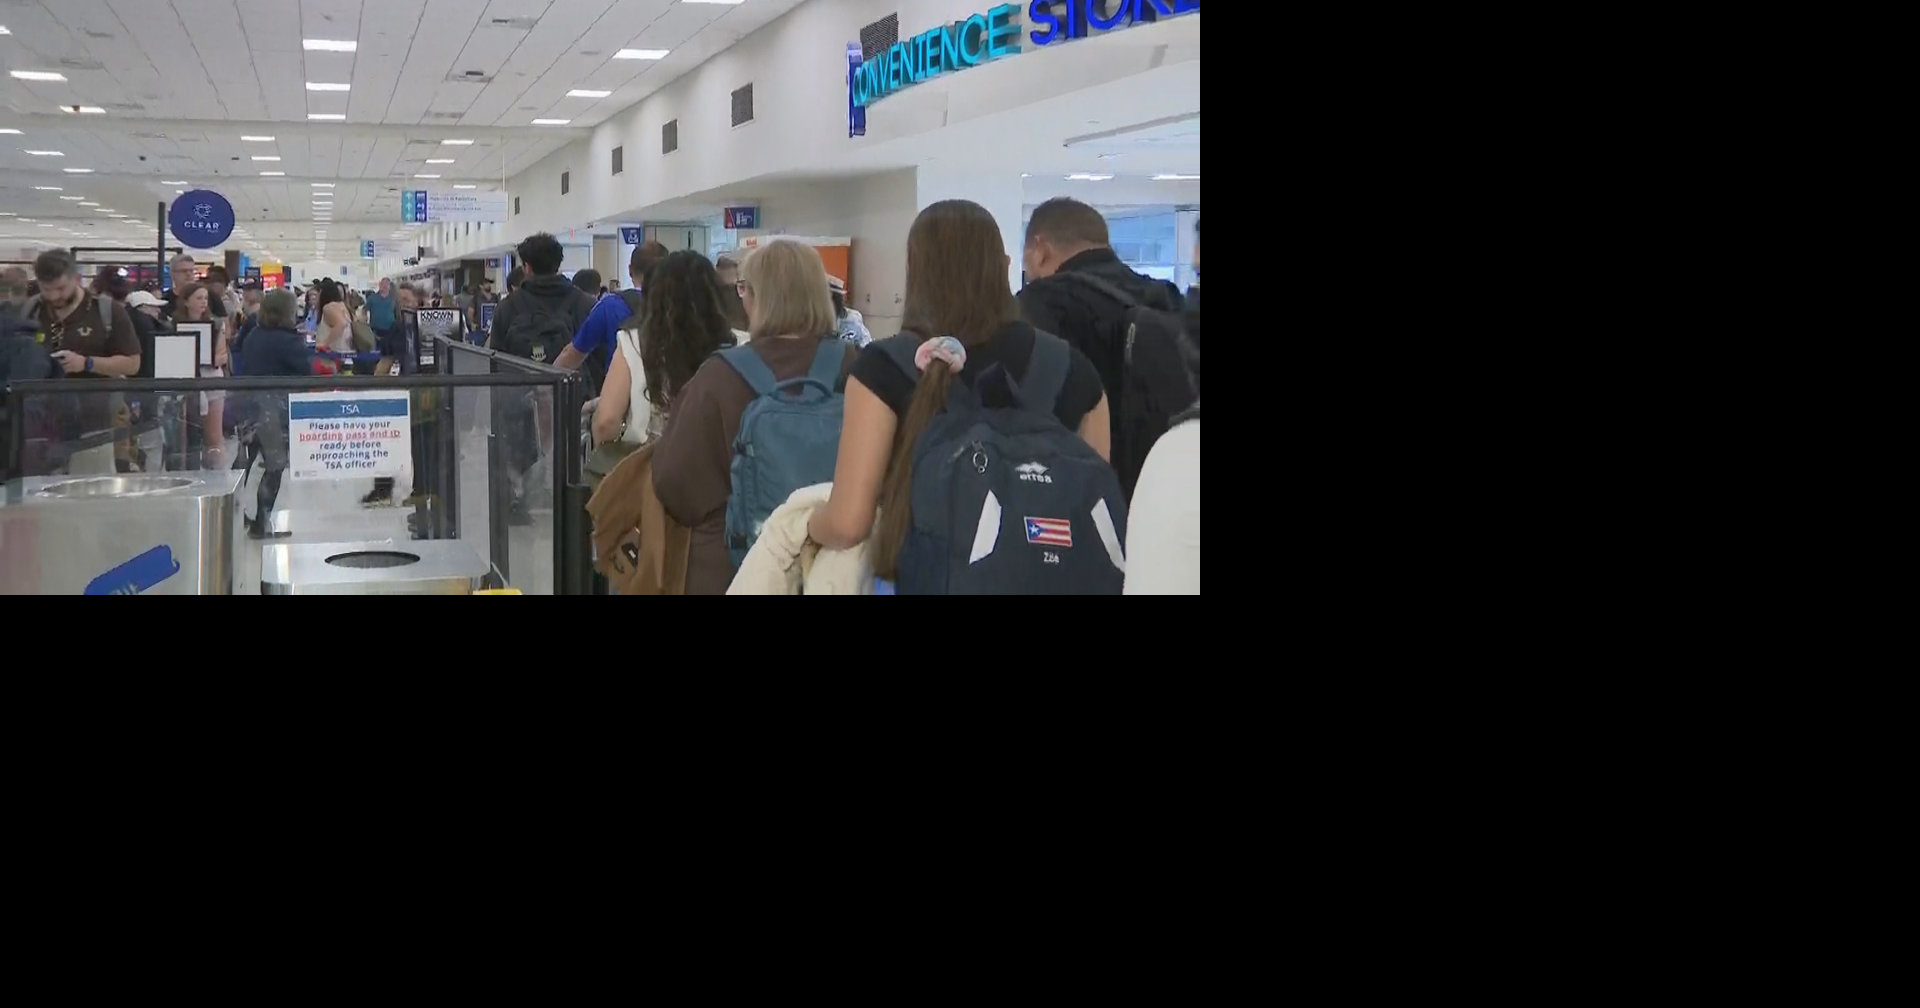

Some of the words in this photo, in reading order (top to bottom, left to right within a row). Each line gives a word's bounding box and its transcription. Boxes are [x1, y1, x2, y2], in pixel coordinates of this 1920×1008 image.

[853, 3, 1022, 107] CONVENIENCE
[184, 221, 219, 230] CLEAR
[421, 310, 453, 321] KNOWN
[341, 404, 360, 414] TSA
[309, 421, 340, 430] Please
[343, 420, 366, 430] have
[369, 420, 391, 431] your
[299, 430, 343, 442] boarding
[346, 430, 367, 440] pass
[369, 429, 388, 438] and
[390, 429, 401, 438] ID
[320, 442, 347, 450] ready
[350, 440, 381, 449] before
[310, 450, 370, 461] approaching
[373, 450, 389, 458] the
[325, 461, 342, 470] TSA
[345, 460, 377, 469] officer
